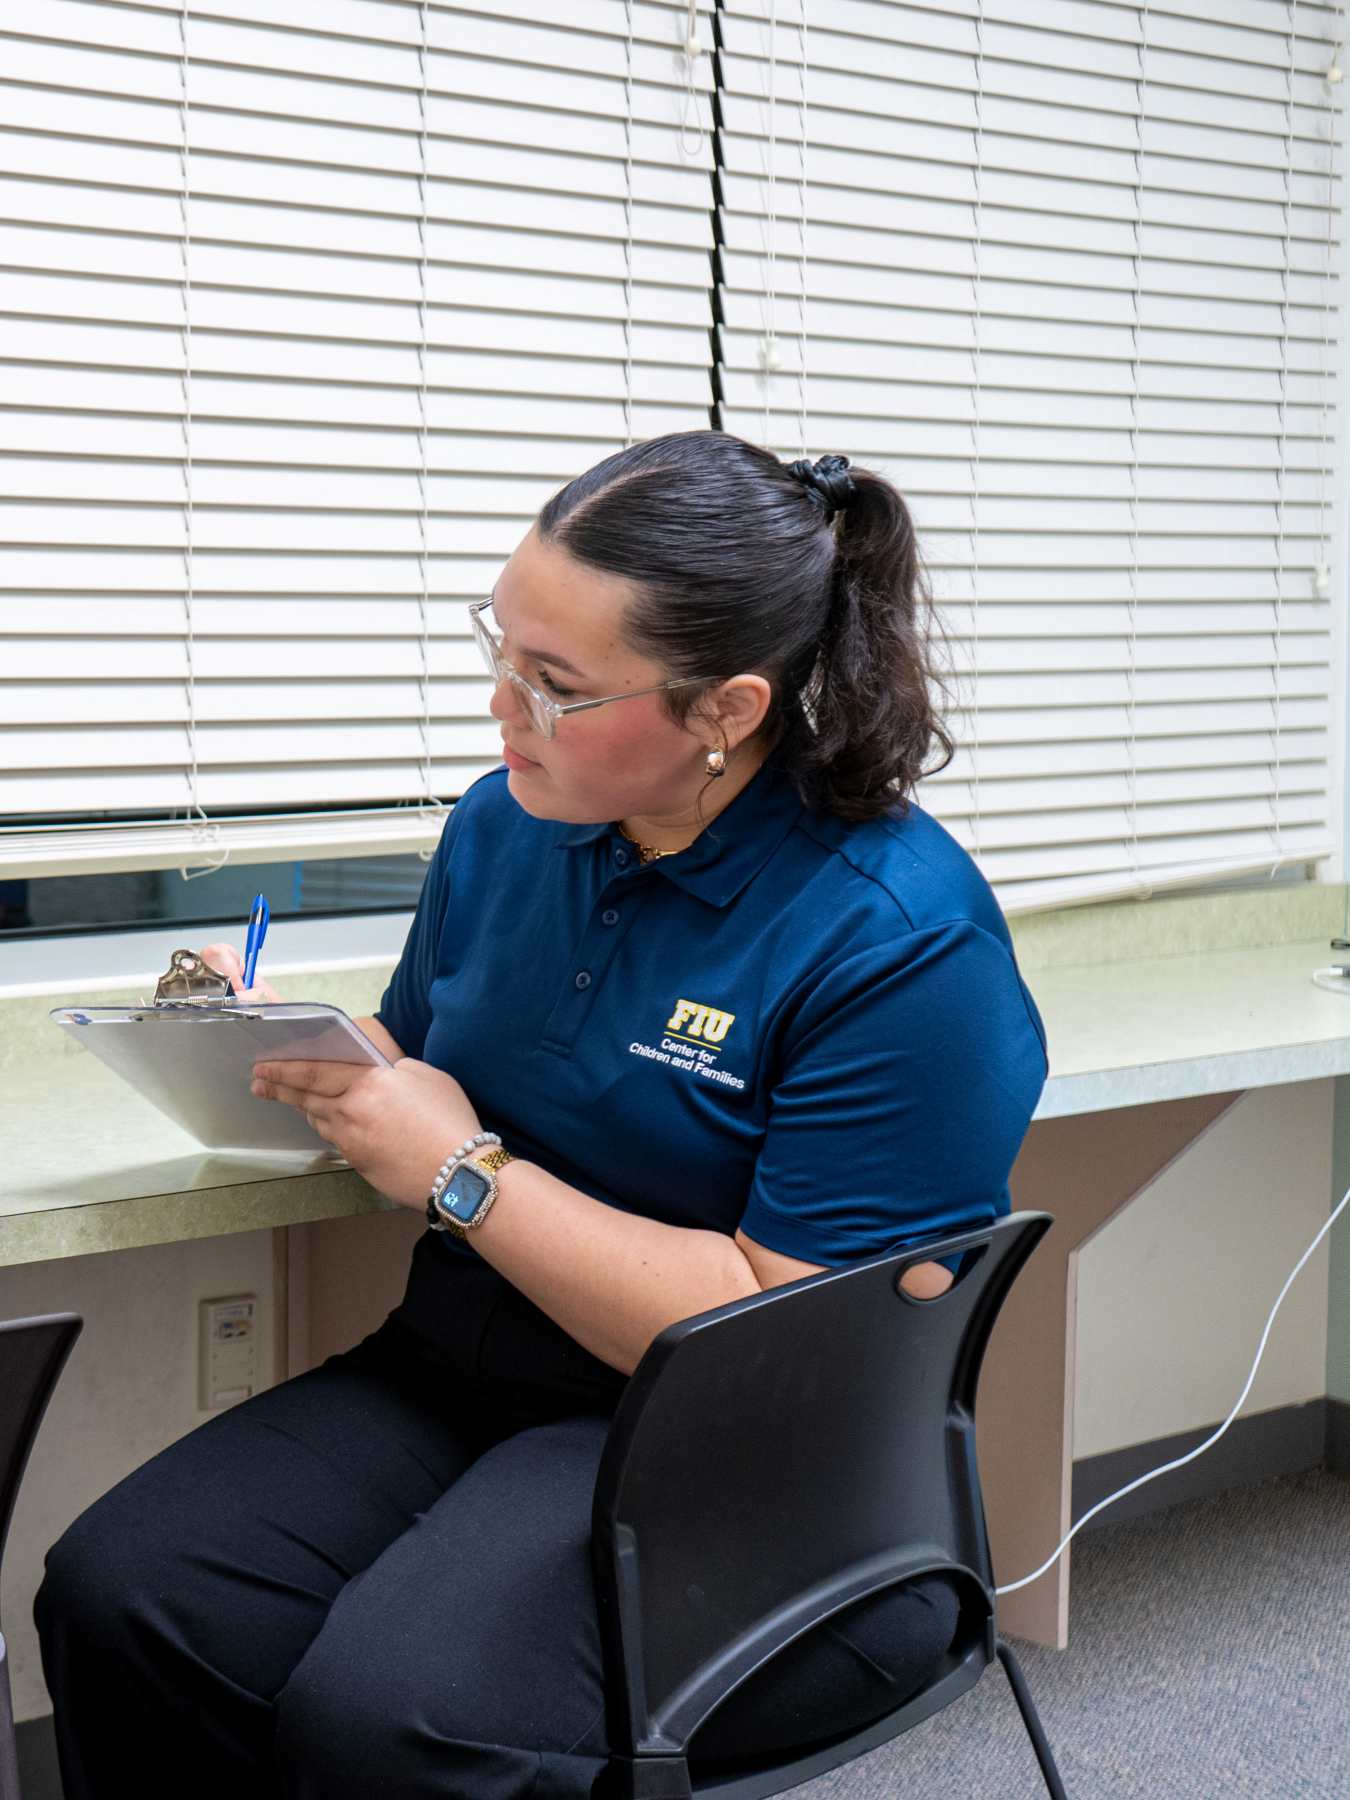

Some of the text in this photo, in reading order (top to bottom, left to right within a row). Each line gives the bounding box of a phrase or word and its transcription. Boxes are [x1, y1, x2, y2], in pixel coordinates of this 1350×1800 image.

[667, 999, 735, 1042] FIU
[629, 1042, 745, 1089] Children and Families
[661, 1038, 717, 1064] Center for
